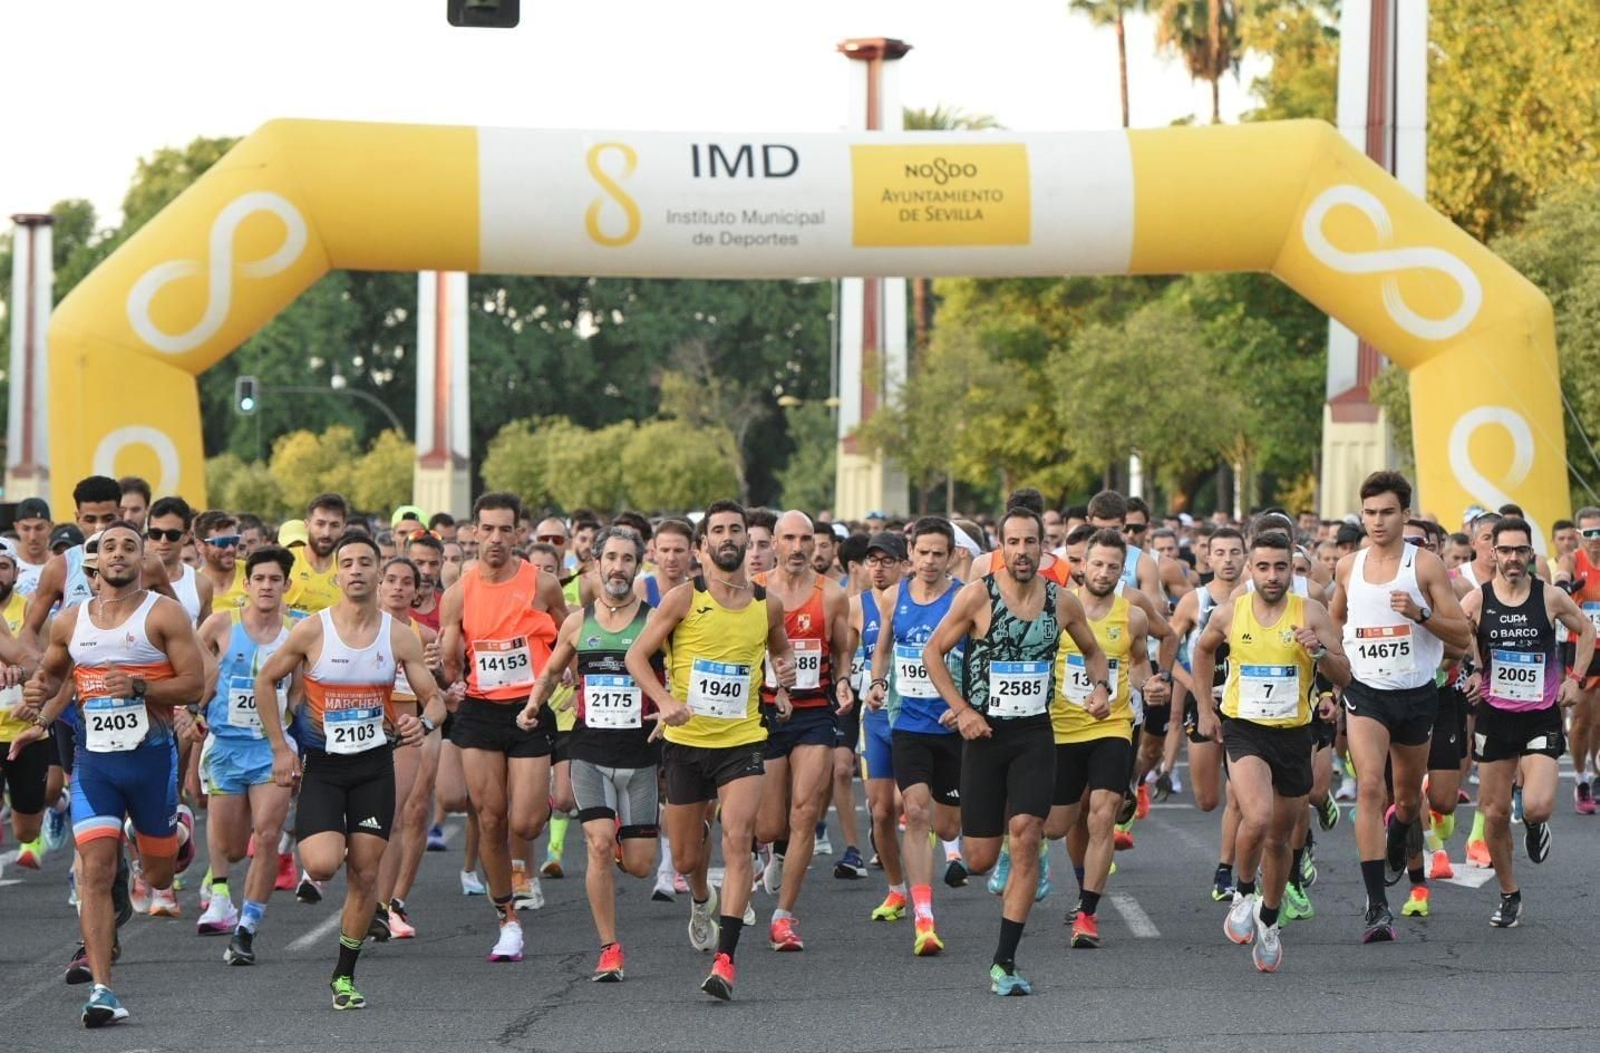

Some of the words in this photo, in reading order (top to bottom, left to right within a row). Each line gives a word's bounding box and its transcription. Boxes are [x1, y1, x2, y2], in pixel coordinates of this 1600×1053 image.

[691, 144, 800, 178] IMD
[666, 209, 736, 224] Instituto
[742, 209, 825, 227] Municipal
[899, 208, 920, 222] DE
[692, 231, 714, 245] de
[719, 231, 798, 247] Deportes
[1490, 630, 1498, 639] O
[1500, 628, 1538, 638] BARCO
[1359, 642, 1410, 658] 14675
[479, 653, 527, 671] 14153
[901, 664, 926, 678] 196
[1498, 667, 1536, 683] 2005
[999, 680, 1041, 695] 2585
[1072, 672, 1090, 687] 13
[699, 679, 741, 697] 1940
[1263, 684, 1274, 698] 7
[237, 695, 256, 708] 20
[592, 693, 632, 707] 2175
[92, 713, 138, 731] 2403
[334, 724, 375, 742] 2103
